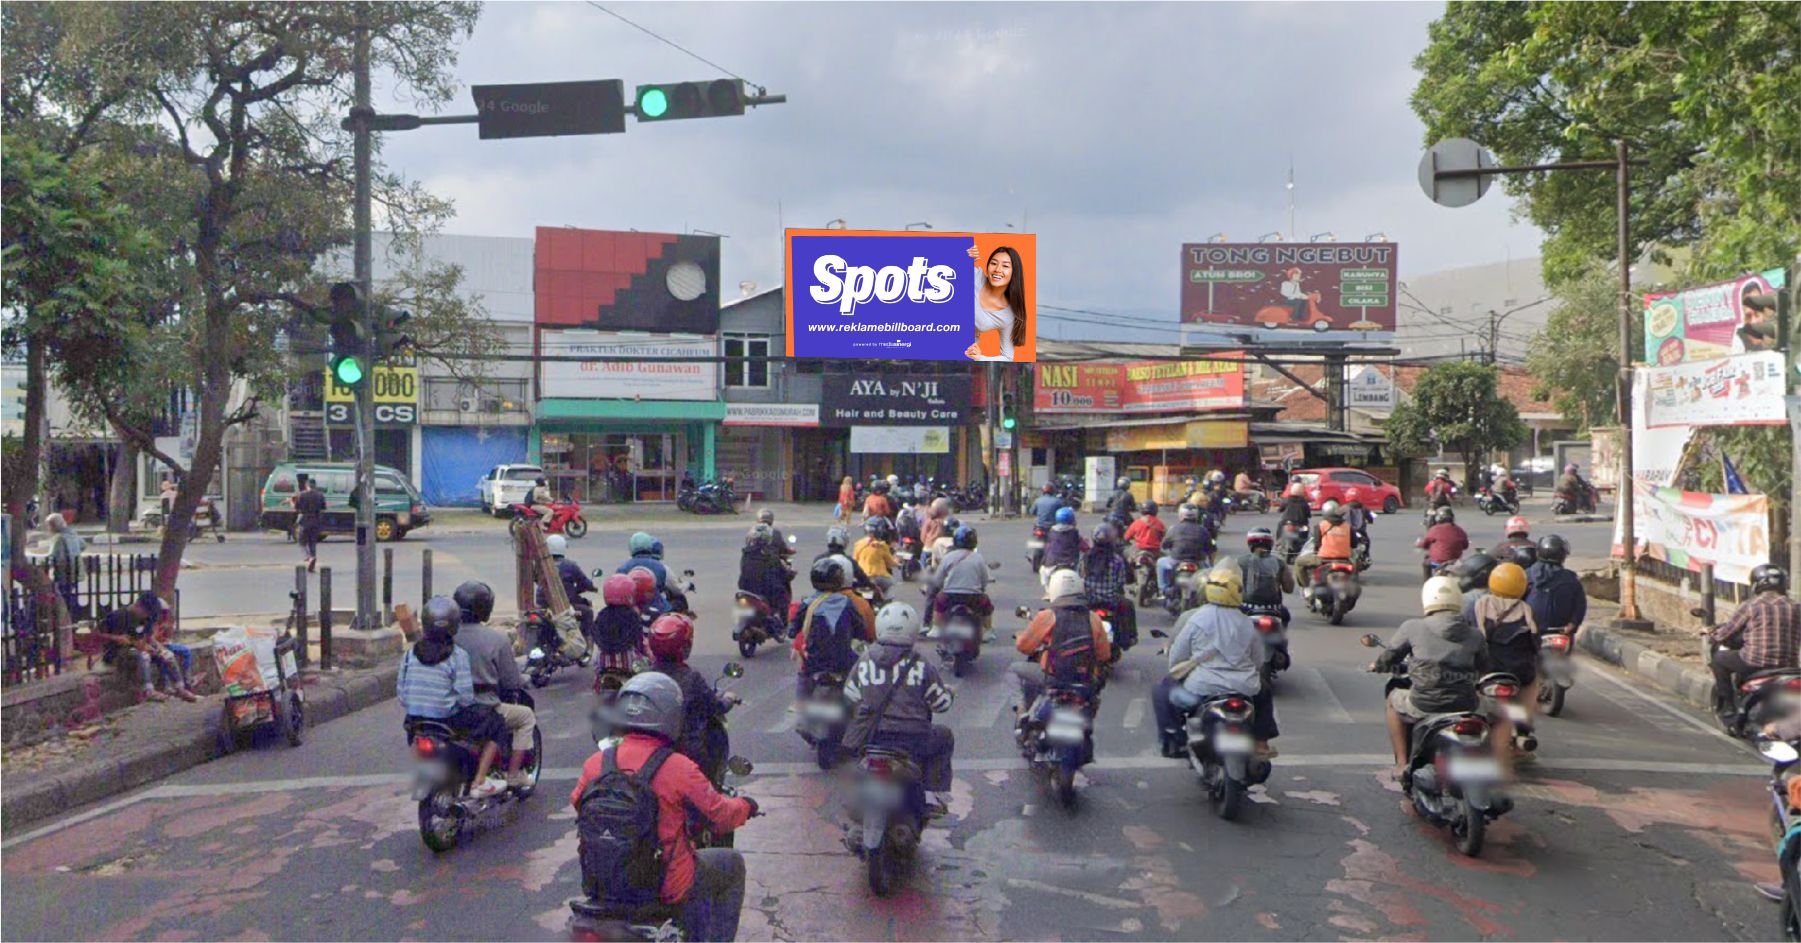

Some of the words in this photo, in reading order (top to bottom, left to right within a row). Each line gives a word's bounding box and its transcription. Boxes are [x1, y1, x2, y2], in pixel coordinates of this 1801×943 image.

[1191, 248, 1270, 264] TONG
[1276, 248, 1393, 264] NGEBUT
[809, 254, 957, 316] Spots
[808, 322, 960, 332] www.reklamebillboard.com
[569, 345, 617, 354] PRAKTEK
[619, 346, 659, 355] DOKTER
[638, 362, 701, 374] Gunawan
[1041, 365, 1078, 387] NASI
[850, 381, 886, 396] AYA
[1353, 392, 1389, 402] LEMBANG
[835, 409, 859, 418] Hair
[863, 409, 884, 418] and
[888, 409, 927, 419] Beauty
[930, 409, 958, 418] Care
